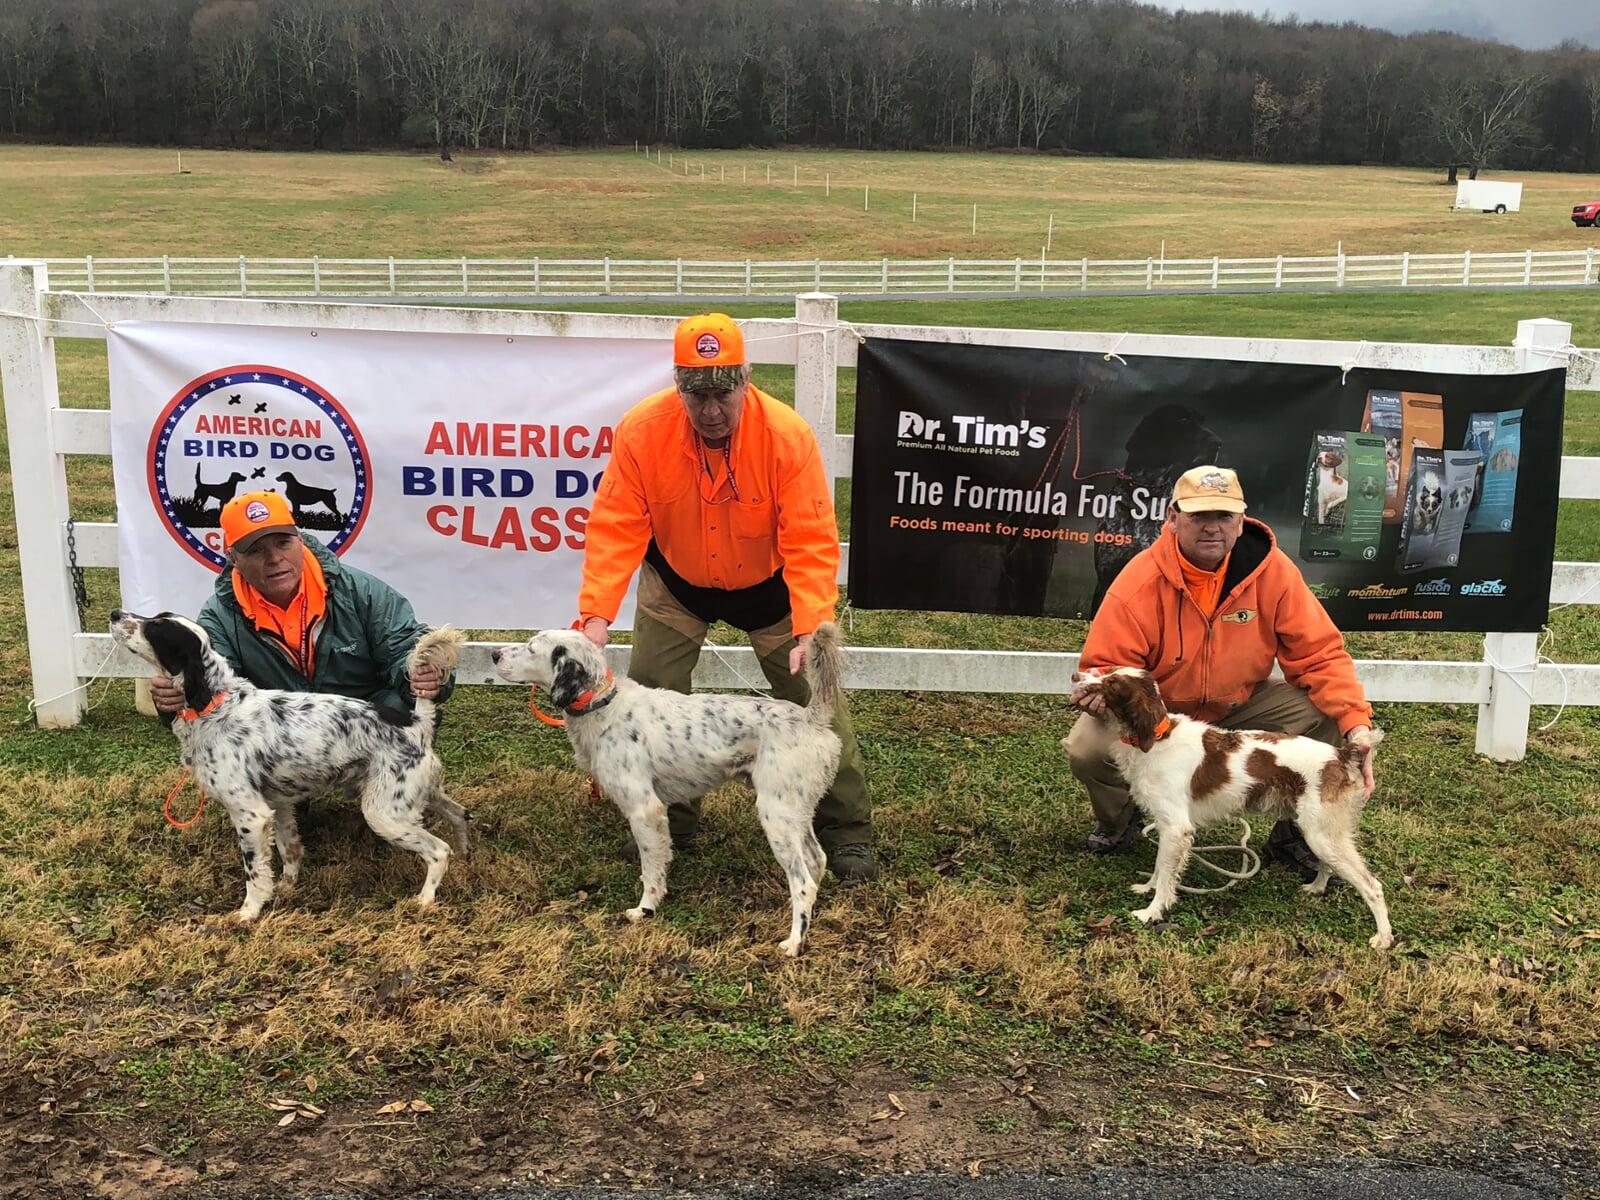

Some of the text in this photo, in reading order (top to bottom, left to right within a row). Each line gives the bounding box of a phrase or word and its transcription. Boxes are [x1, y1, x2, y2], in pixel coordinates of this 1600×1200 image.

[195, 414, 322, 439] AMERICAN
[898, 410, 1047, 449] Dr. Tim's
[183, 439, 335, 461] BIRD DOG
[424, 421, 614, 459] AMERICA
[896, 440, 1020, 457] Premium All Natural Pet Foods
[402, 466, 534, 498] BIRD
[894, 471, 1167, 521] The Formula For Su
[426, 504, 590, 553] CLASS
[890, 516, 1133, 545] Foods meant for sporting dogs
[1347, 586, 1408, 598] momentum
[1415, 581, 1451, 593] fusion
[1460, 582, 1507, 596] glacier
[1367, 609, 1443, 621] www.drtims.com
